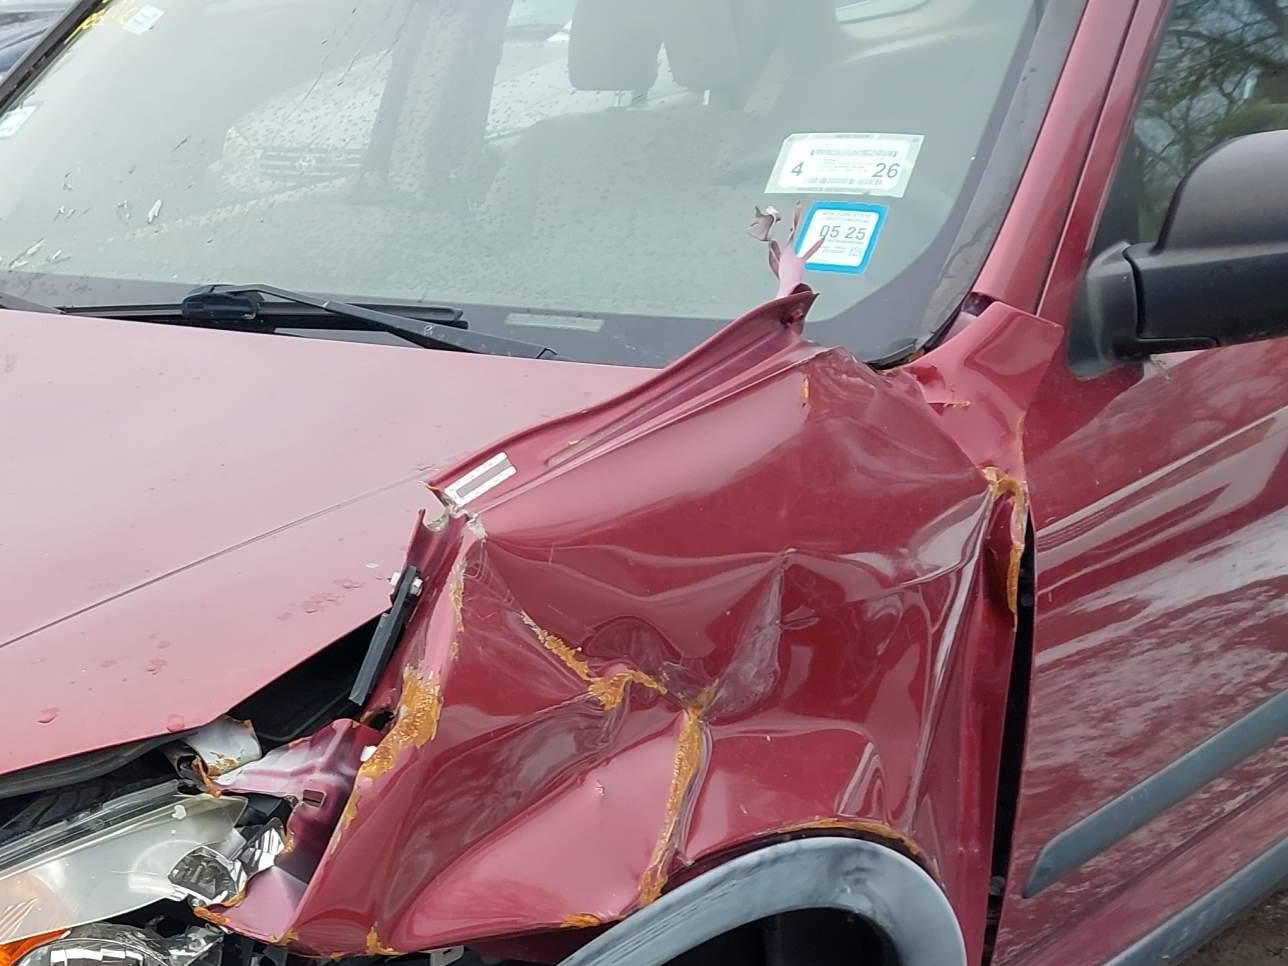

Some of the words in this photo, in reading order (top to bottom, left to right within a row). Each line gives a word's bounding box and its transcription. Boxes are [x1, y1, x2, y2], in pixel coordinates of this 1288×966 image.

[791, 161, 803, 176] 4
[872, 163, 899, 178] 26
[820, 225, 840, 238] 05
[844, 226, 867, 240] 25
